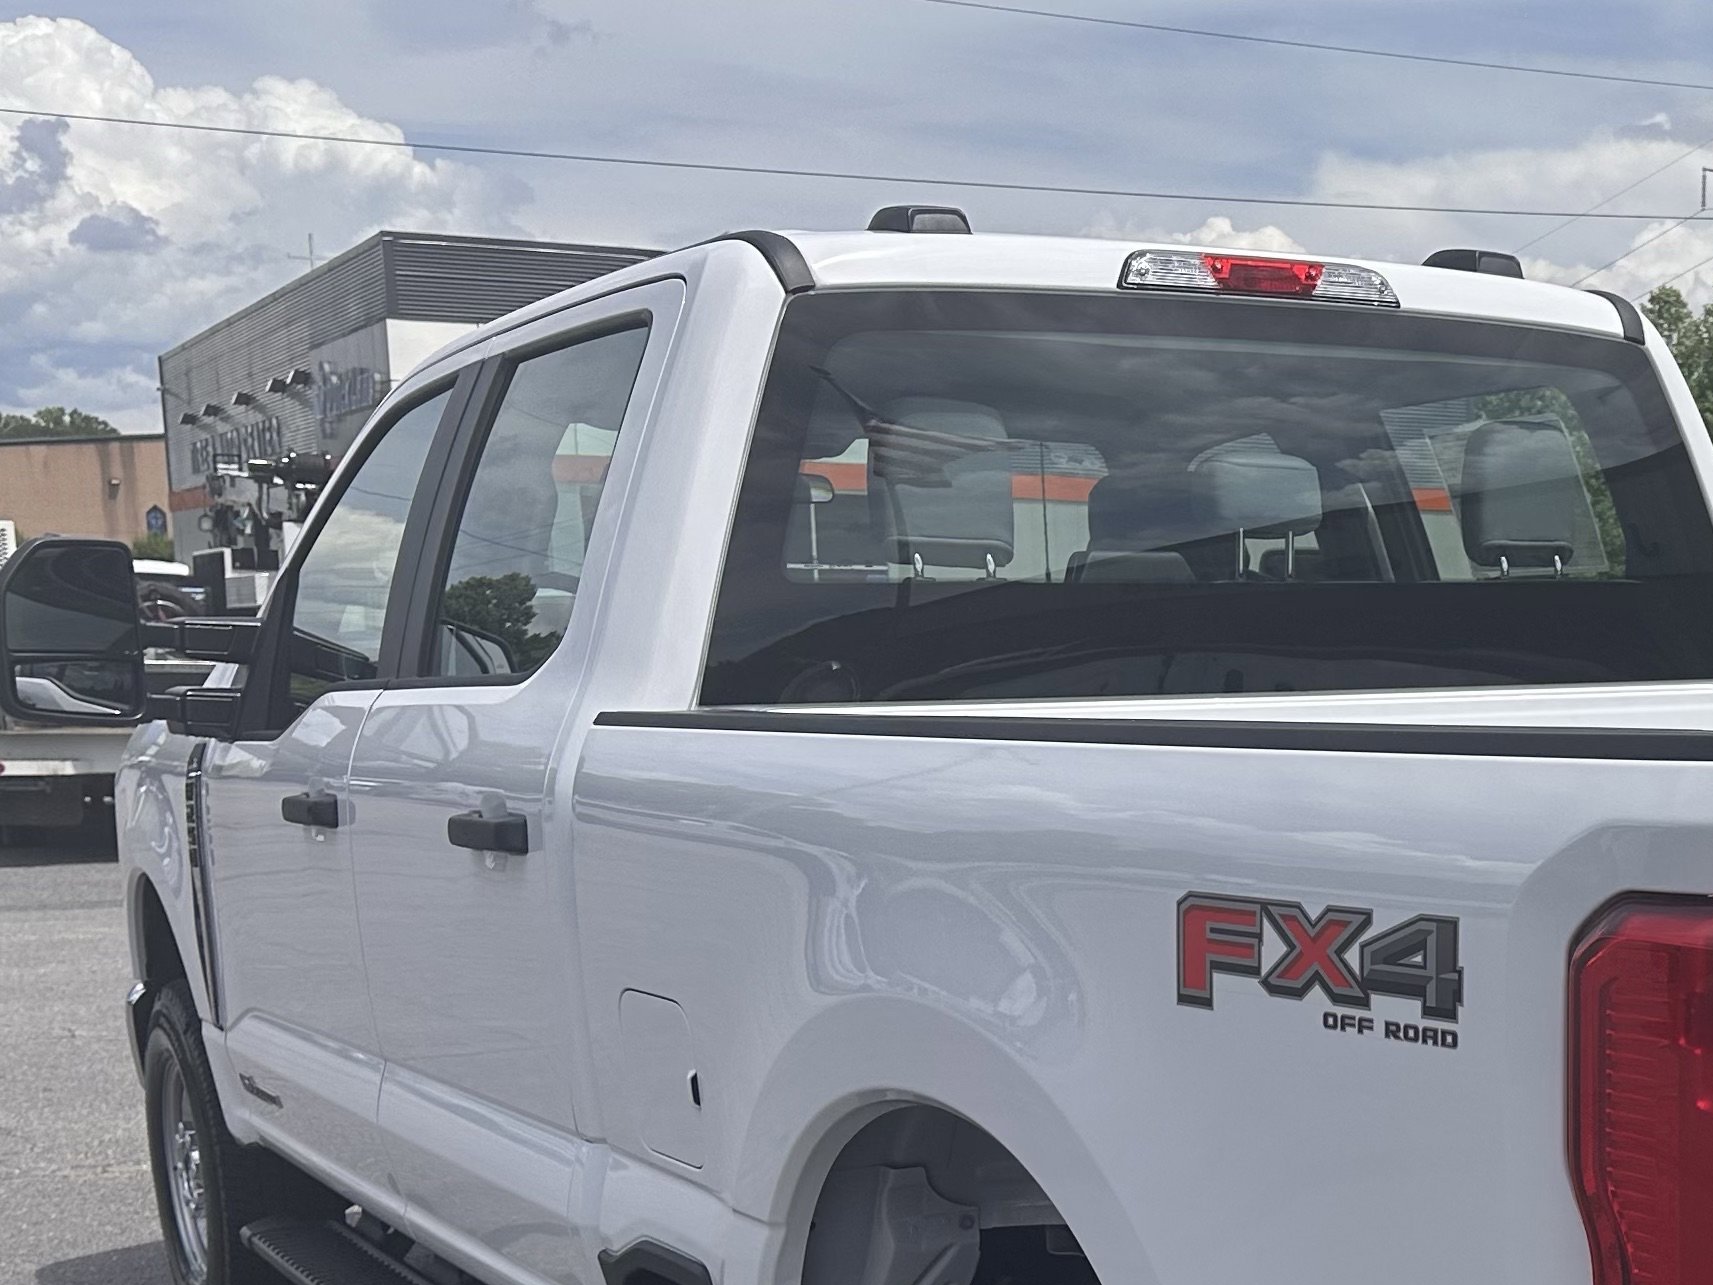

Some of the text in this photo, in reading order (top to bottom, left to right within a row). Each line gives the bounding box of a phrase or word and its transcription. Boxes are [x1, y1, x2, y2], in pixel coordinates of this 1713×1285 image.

[1177, 890, 1464, 1023] FX4
[1322, 1011, 1459, 1050] OFF ROAD
